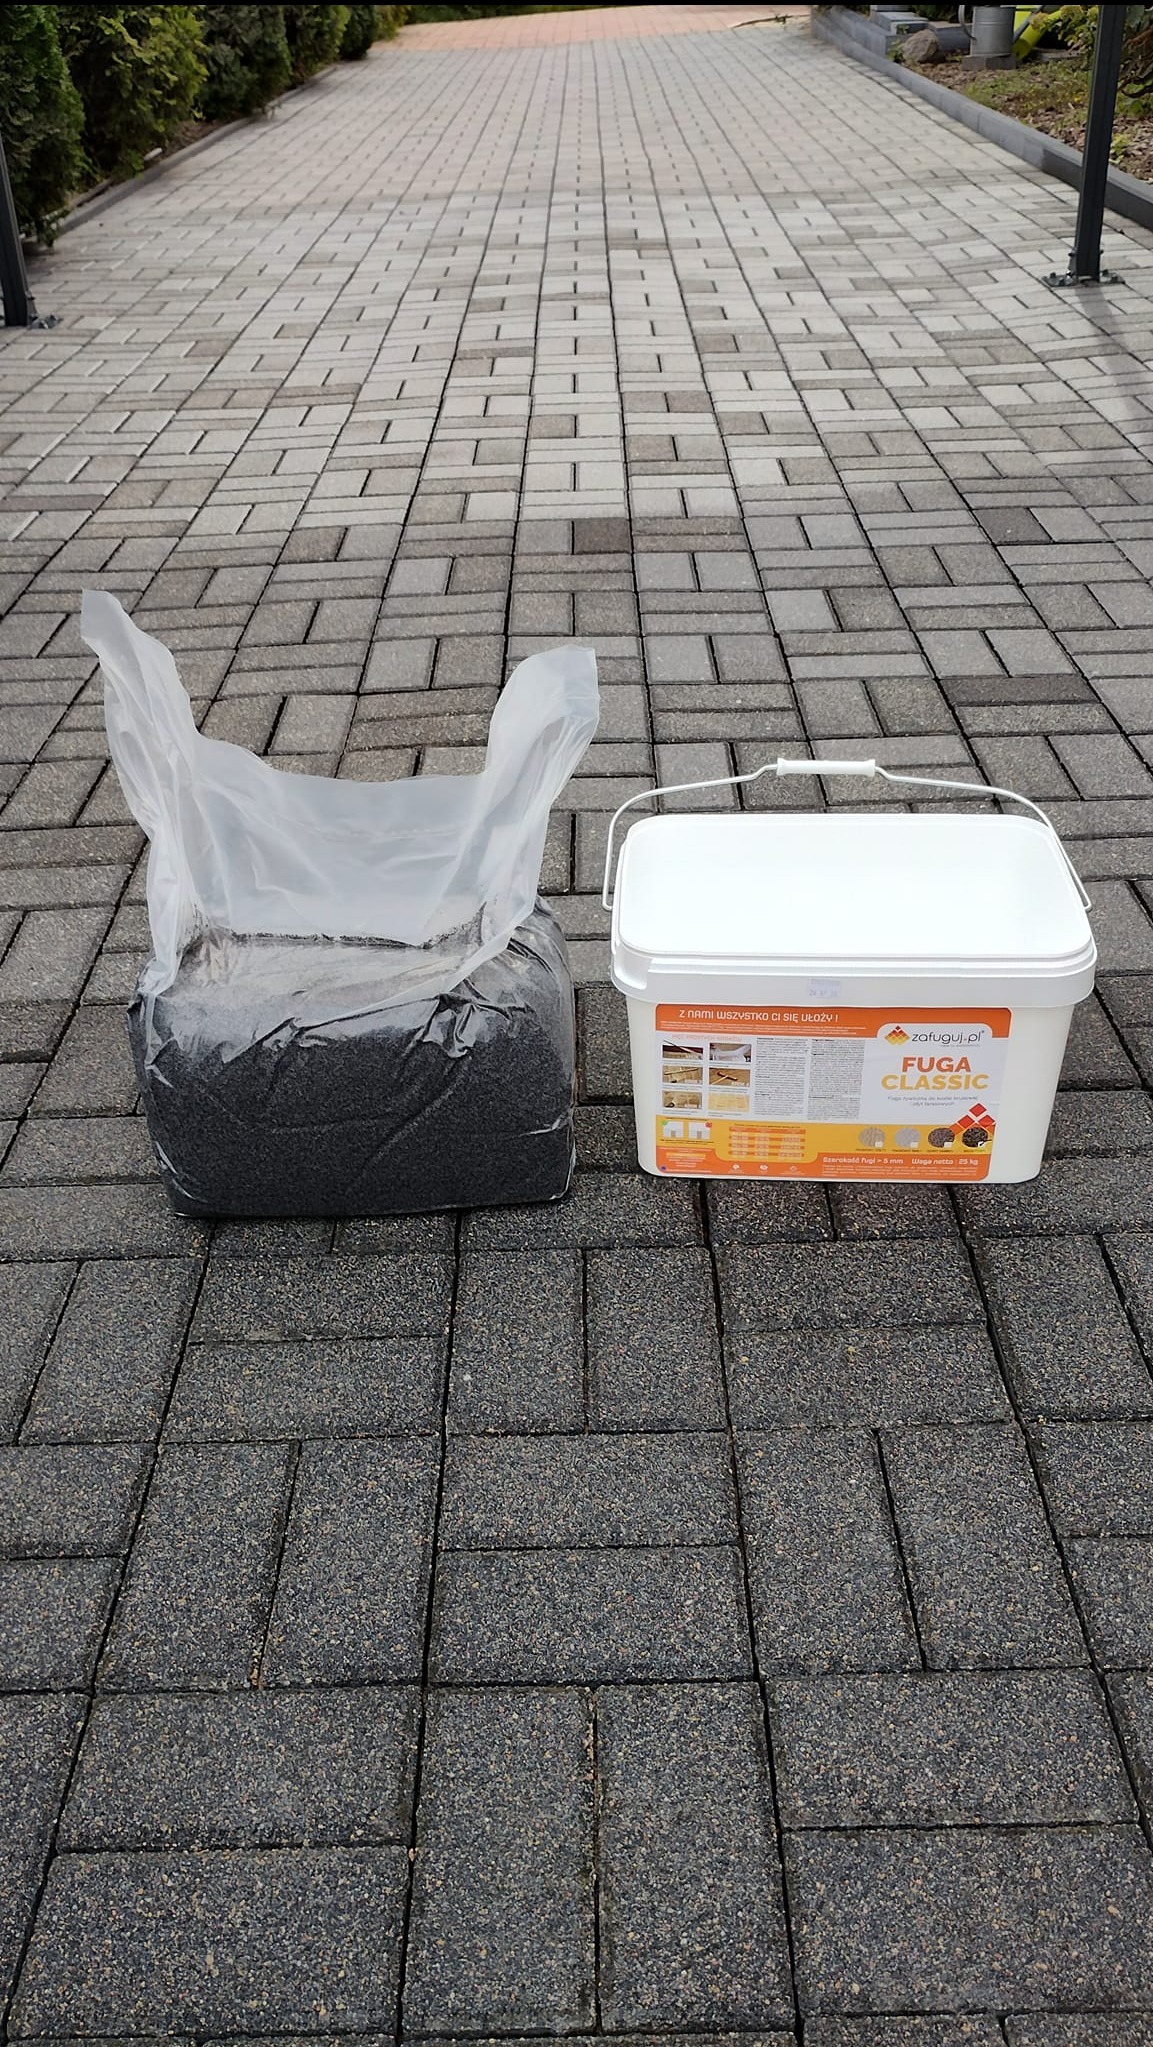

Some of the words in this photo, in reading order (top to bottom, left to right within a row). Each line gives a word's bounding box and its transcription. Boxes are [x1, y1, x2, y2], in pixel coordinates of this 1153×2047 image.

[679, 1010, 685, 1018] Z
[687, 1010, 714, 1019] NAMI
[716, 1011, 769, 1021] WSZYSTKO
[771, 1012, 781, 1021] CI
[783, 1013, 799, 1023] SIĘ
[801, 1012, 833, 1022] UŁOŻY
[902, 1056, 971, 1073] FUGA
[881, 1074, 989, 1091] CLASSIC
[822, 1156, 860, 1164] Szerokość
[861, 1157, 876, 1165] fugi
[911, 1158, 932, 1166] Waga
[969, 1158, 979, 1166] kg
